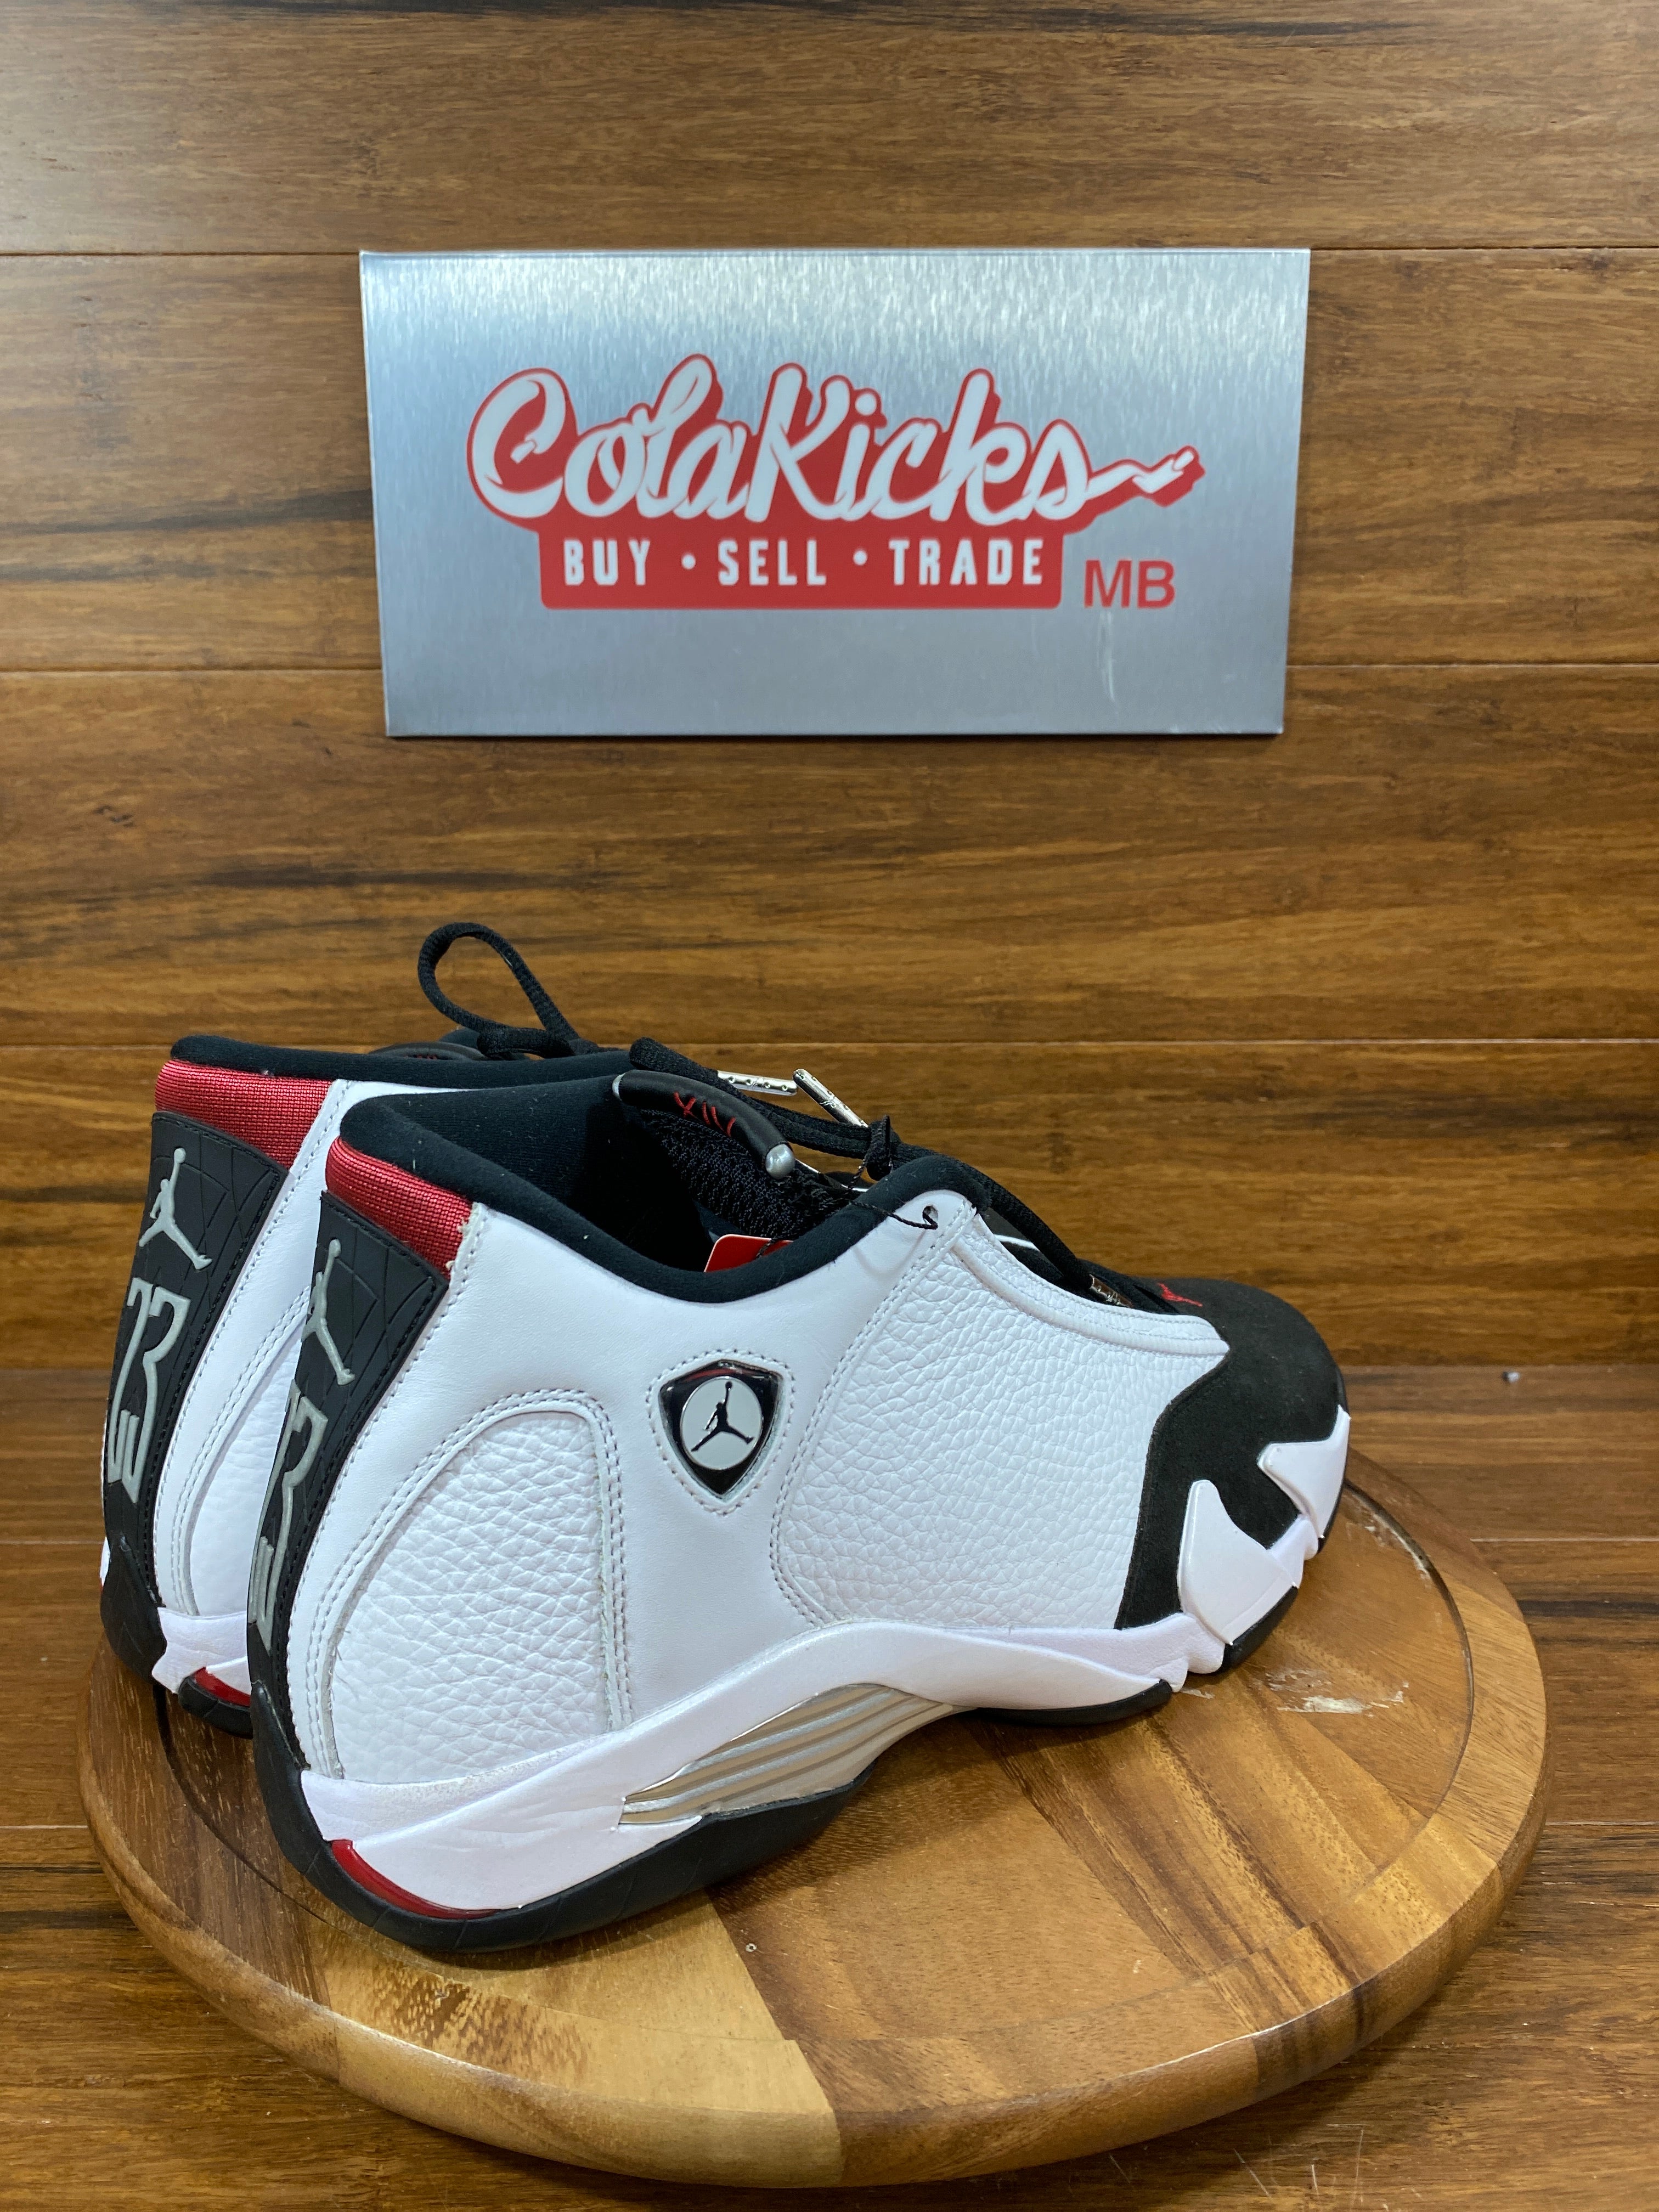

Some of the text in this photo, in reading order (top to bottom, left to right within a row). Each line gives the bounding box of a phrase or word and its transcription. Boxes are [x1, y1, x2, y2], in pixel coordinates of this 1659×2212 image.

[470, 354, 1197, 526] ColaKicks
[563, 538, 1044, 586] BUY SELL TRADE
[1084, 559, 1176, 608] MB
